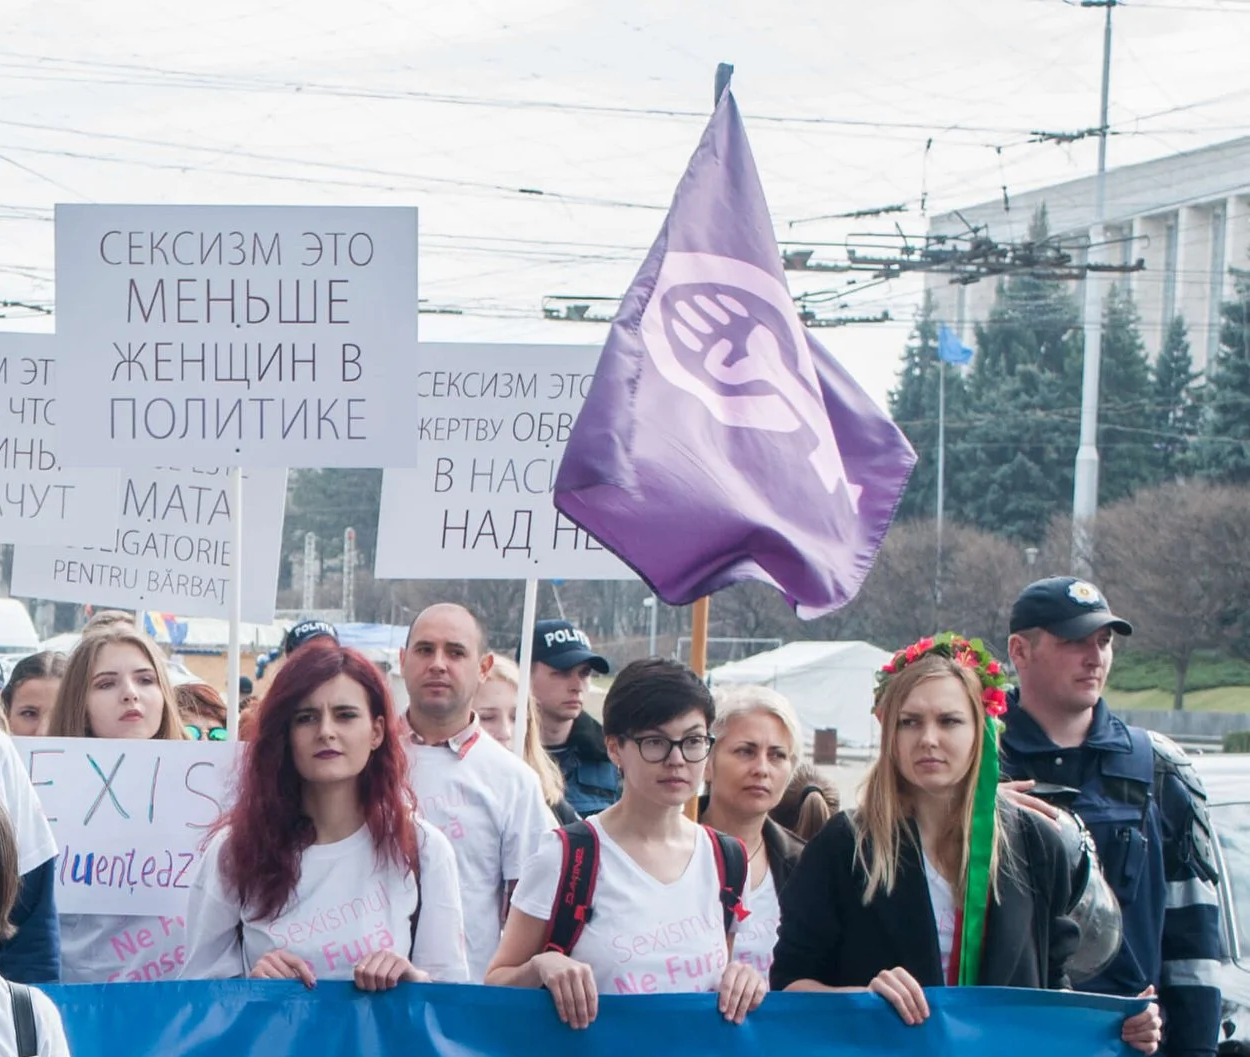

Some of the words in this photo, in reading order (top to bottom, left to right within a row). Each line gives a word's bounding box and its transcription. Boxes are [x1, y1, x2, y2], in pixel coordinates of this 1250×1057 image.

[100, 230, 282, 266] СЕКСИЗМ
[300, 232, 374, 266] ЭТО
[127, 278, 350, 324] МЕНЬШЕ
[20, 358, 56, 385] ЭТ
[111, 342, 315, 390] ЖЕНЩИН
[342, 343, 363, 382] В
[110, 398, 366, 440] ПОЛИТИКЕ
[512, 412, 573, 443] ОБВ
[434, 457, 454, 493] В
[123, 478, 231, 526] MATA
[442, 509, 532, 559] НАД
[53, 559, 138, 589] PENTRU
[146, 568, 230, 605] BĂRBAȚ
[30, 749, 224, 829] EXIS
[268, 880, 391, 950] Sexismul
[110, 928, 155, 961] Ne
[613, 972, 658, 993] Ne
[665, 942, 726, 985] Fură
